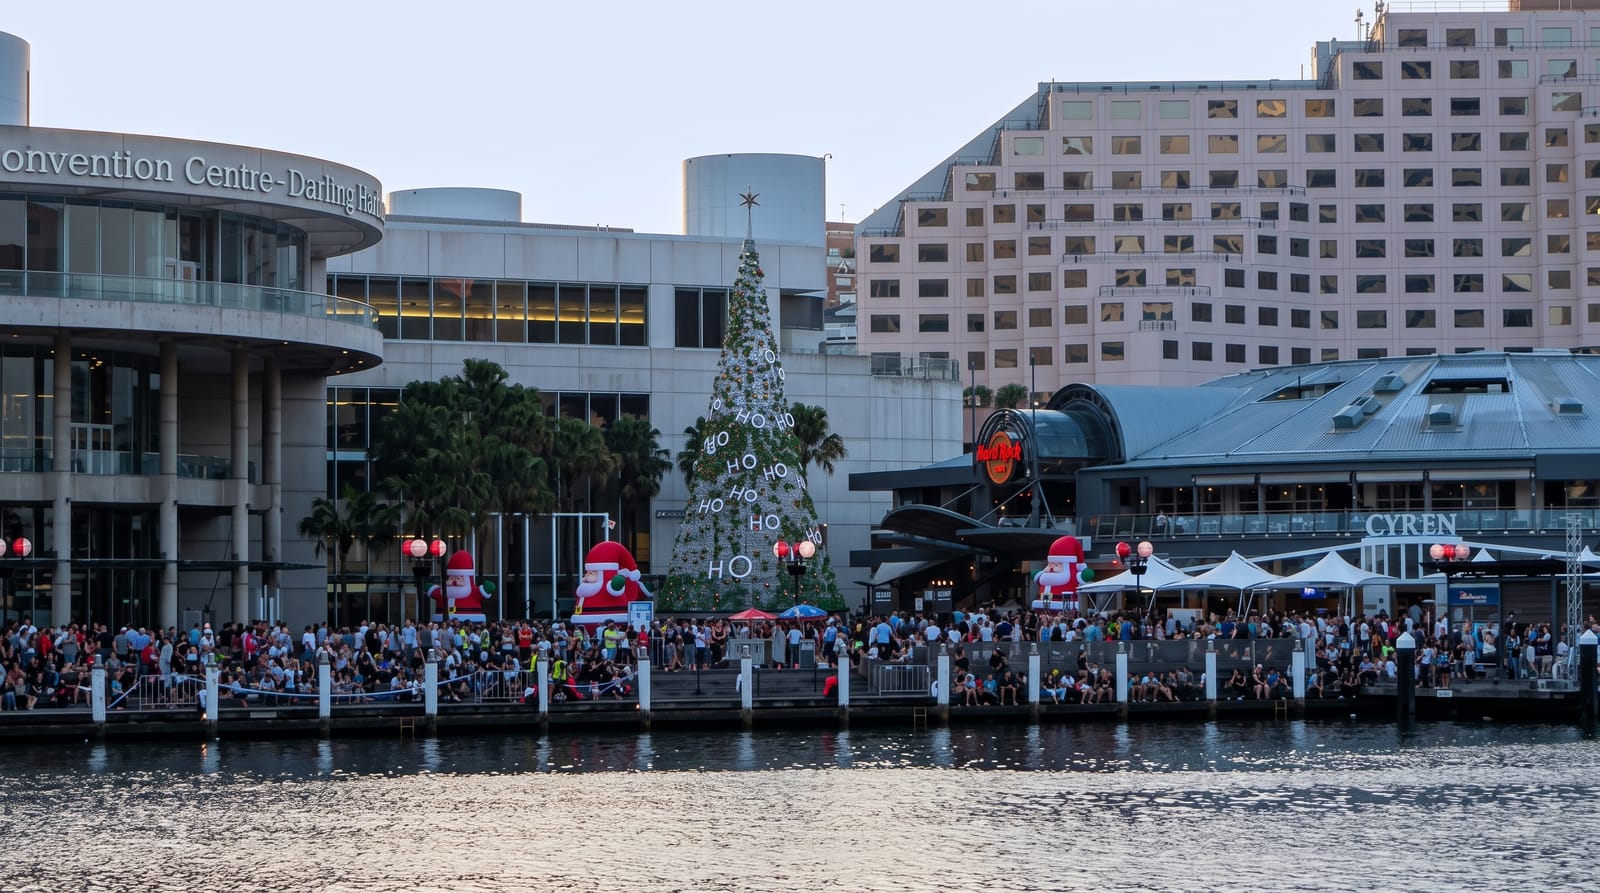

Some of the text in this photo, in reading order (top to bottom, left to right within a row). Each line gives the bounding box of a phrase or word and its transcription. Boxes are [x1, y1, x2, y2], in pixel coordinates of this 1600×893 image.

[2, 149, 174, 182] onvention
[735, 408, 765, 428] HO
[775, 412, 795, 430] HO
[976, 440, 1021, 463] Hard Rock
[727, 454, 757, 474] HO
[763, 462, 787, 481] HO
[729, 484, 758, 502] HO
[698, 498, 724, 514] HO
[750, 514, 780, 531] HO
[1366, 513, 1457, 537] CYREN
[805, 527, 823, 545] HO
[708, 556, 752, 580] HO
